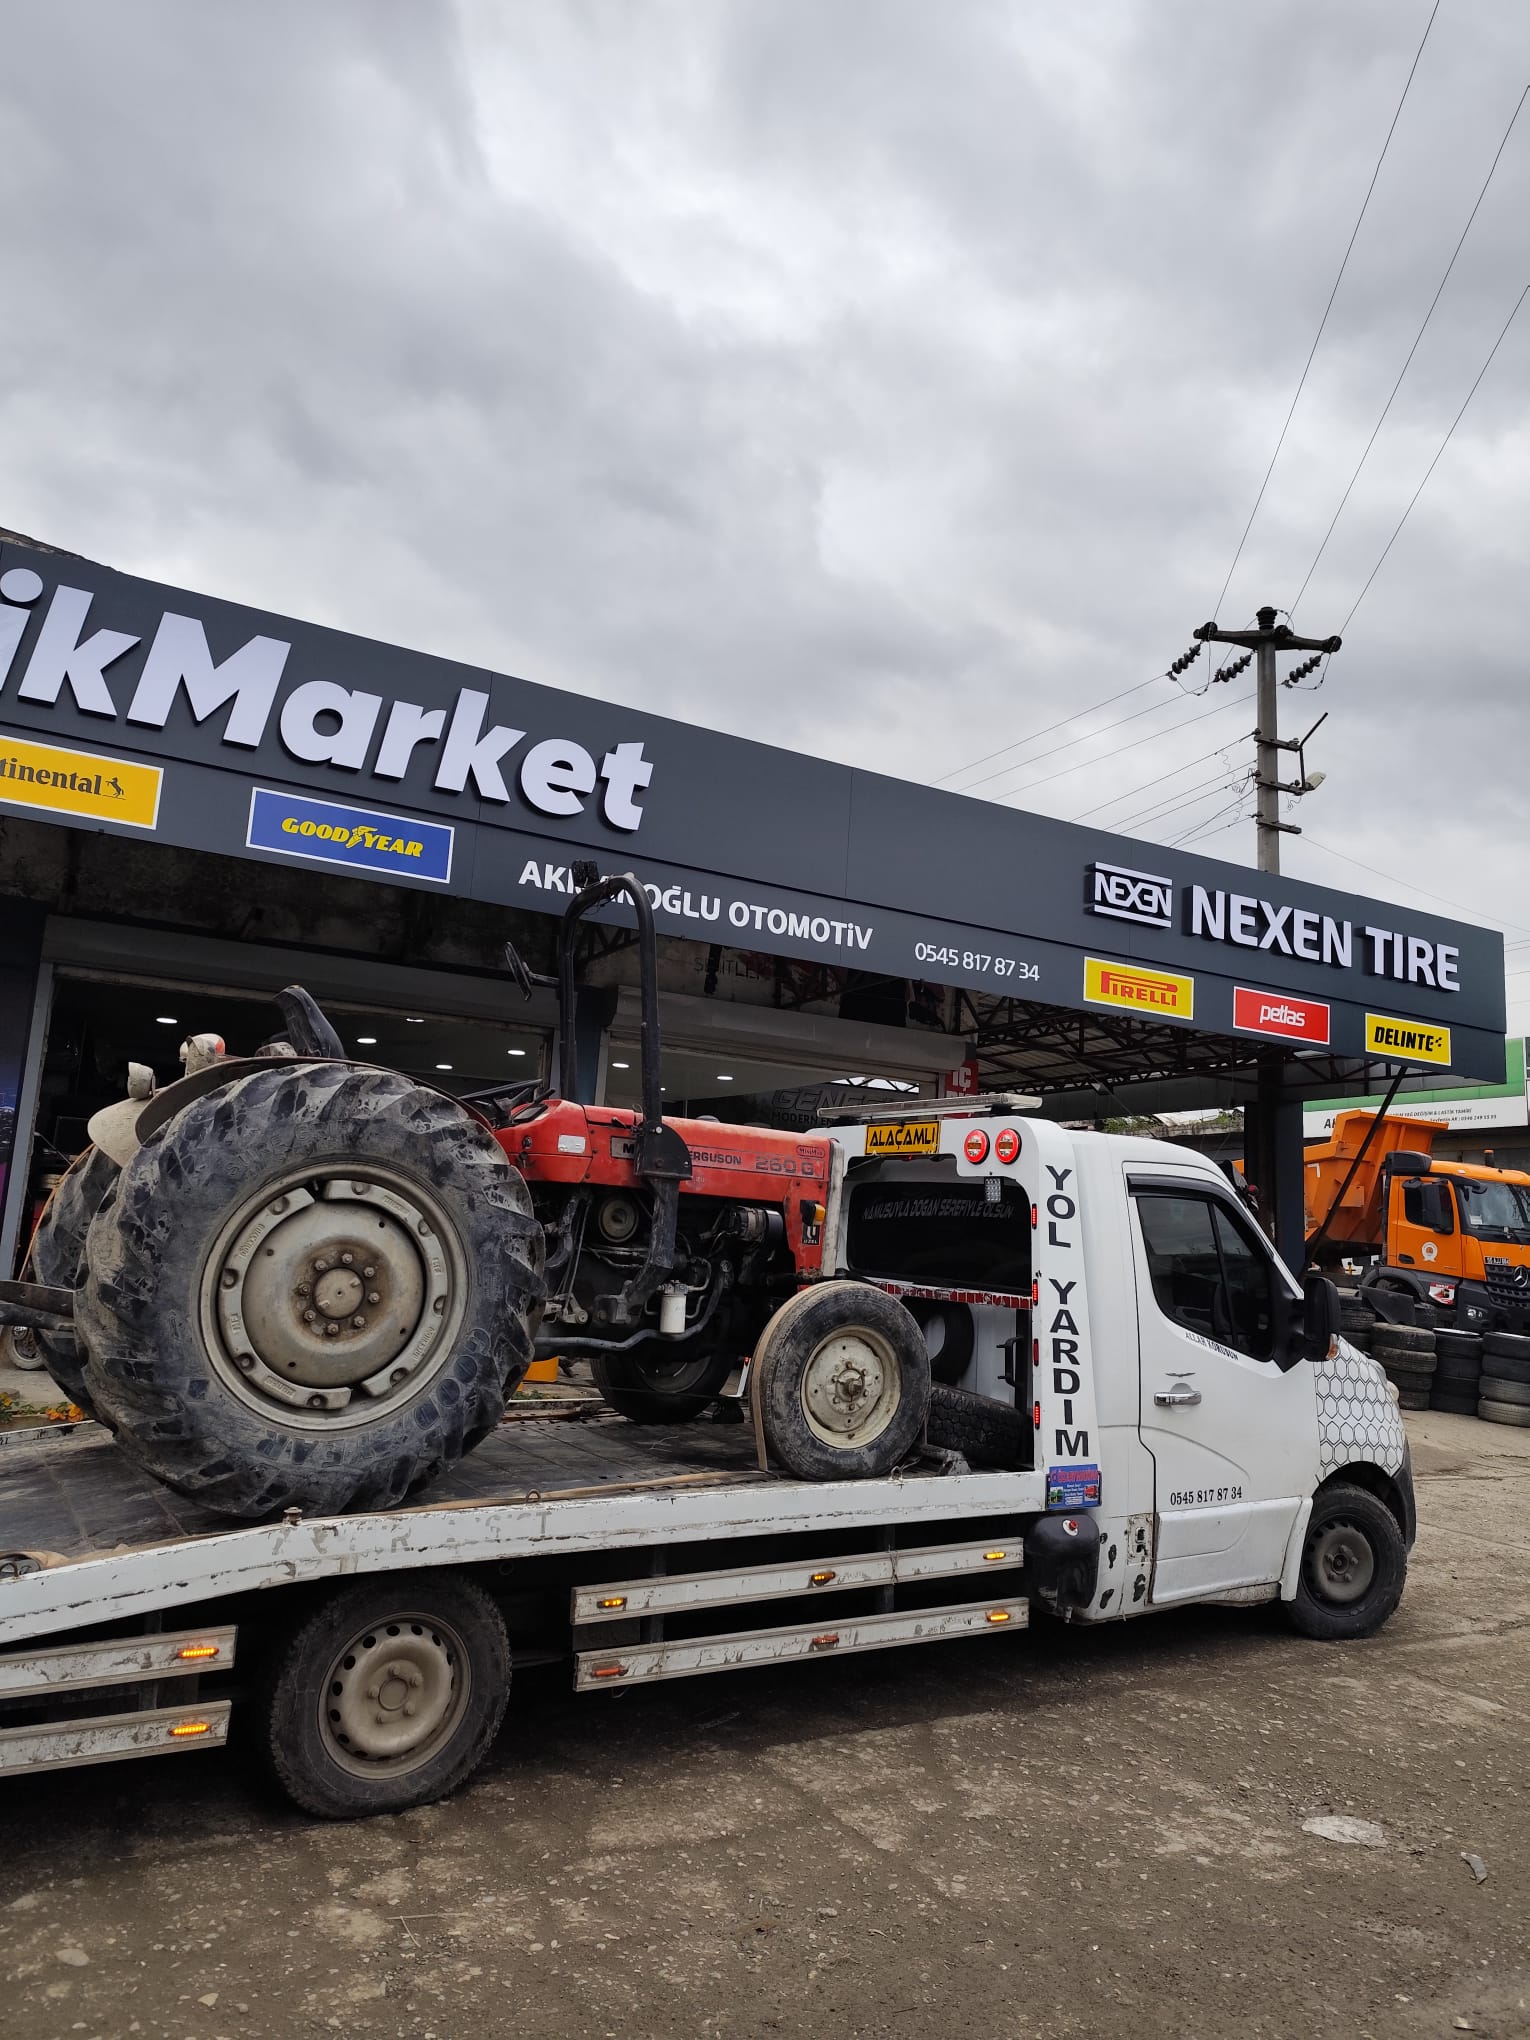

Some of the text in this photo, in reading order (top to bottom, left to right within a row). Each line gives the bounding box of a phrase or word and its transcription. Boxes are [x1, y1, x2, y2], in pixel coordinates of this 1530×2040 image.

[281, 816, 424, 858] GOODYEAR
[1192, 884, 1461, 992] NEXEN TIRE
[914, 942, 1040, 982] 0545 817 87 34
[1100, 970, 1178, 1006] PIRELLI
[1259, 1004, 1306, 1028] petlas
[1373, 1026, 1434, 1052] DELINTE
[869, 1126, 937, 1150] ALAÇAMLI
[1045, 1165, 1076, 1248] YOL
[1048, 1278, 1090, 1458] YARDIM
[1170, 1485, 1242, 1505] 0545 817 87 34
